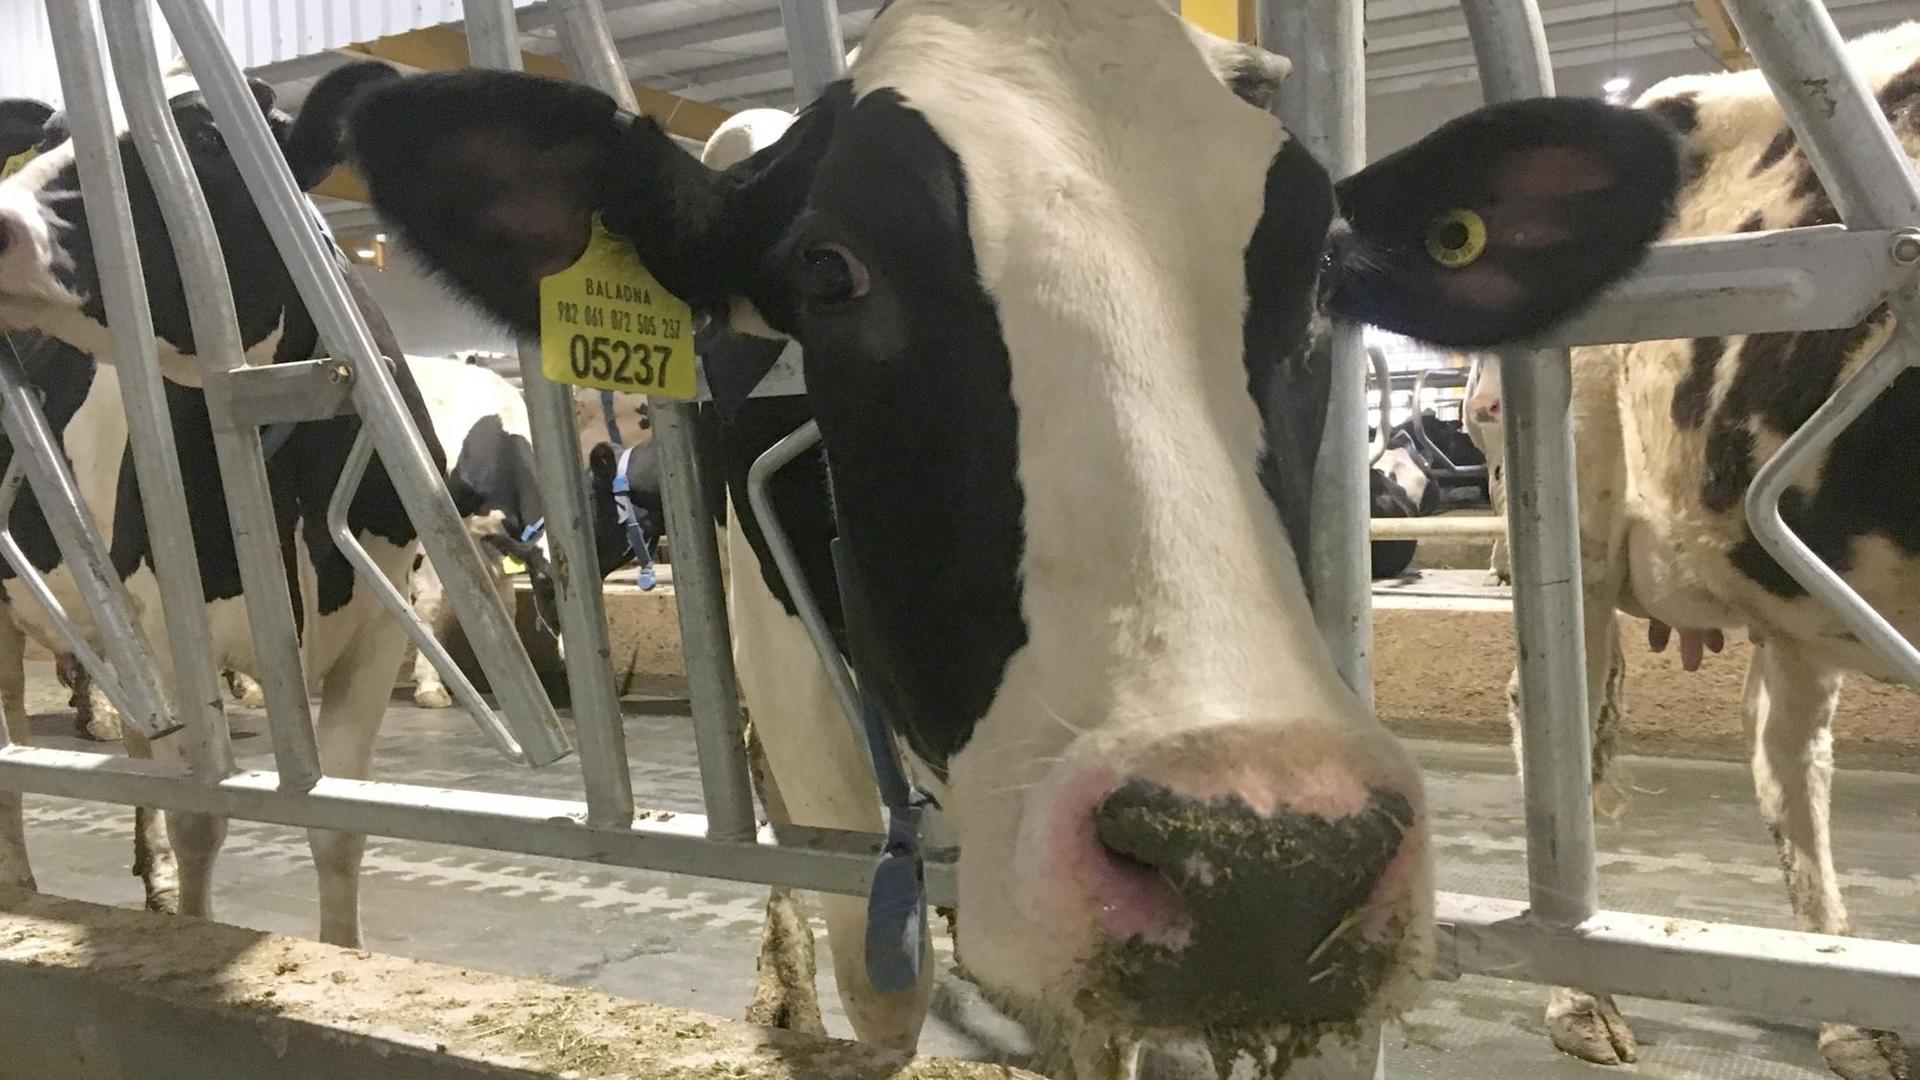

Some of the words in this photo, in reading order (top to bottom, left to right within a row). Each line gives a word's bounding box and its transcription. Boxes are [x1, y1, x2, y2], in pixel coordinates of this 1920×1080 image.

[585, 278, 651, 304] BALADNA
[557, 301, 578, 324] 982
[584, 305, 604, 328] 061
[611, 309, 631, 333] 072
[662, 318, 681, 340] 237
[570, 334, 672, 388] 05237
